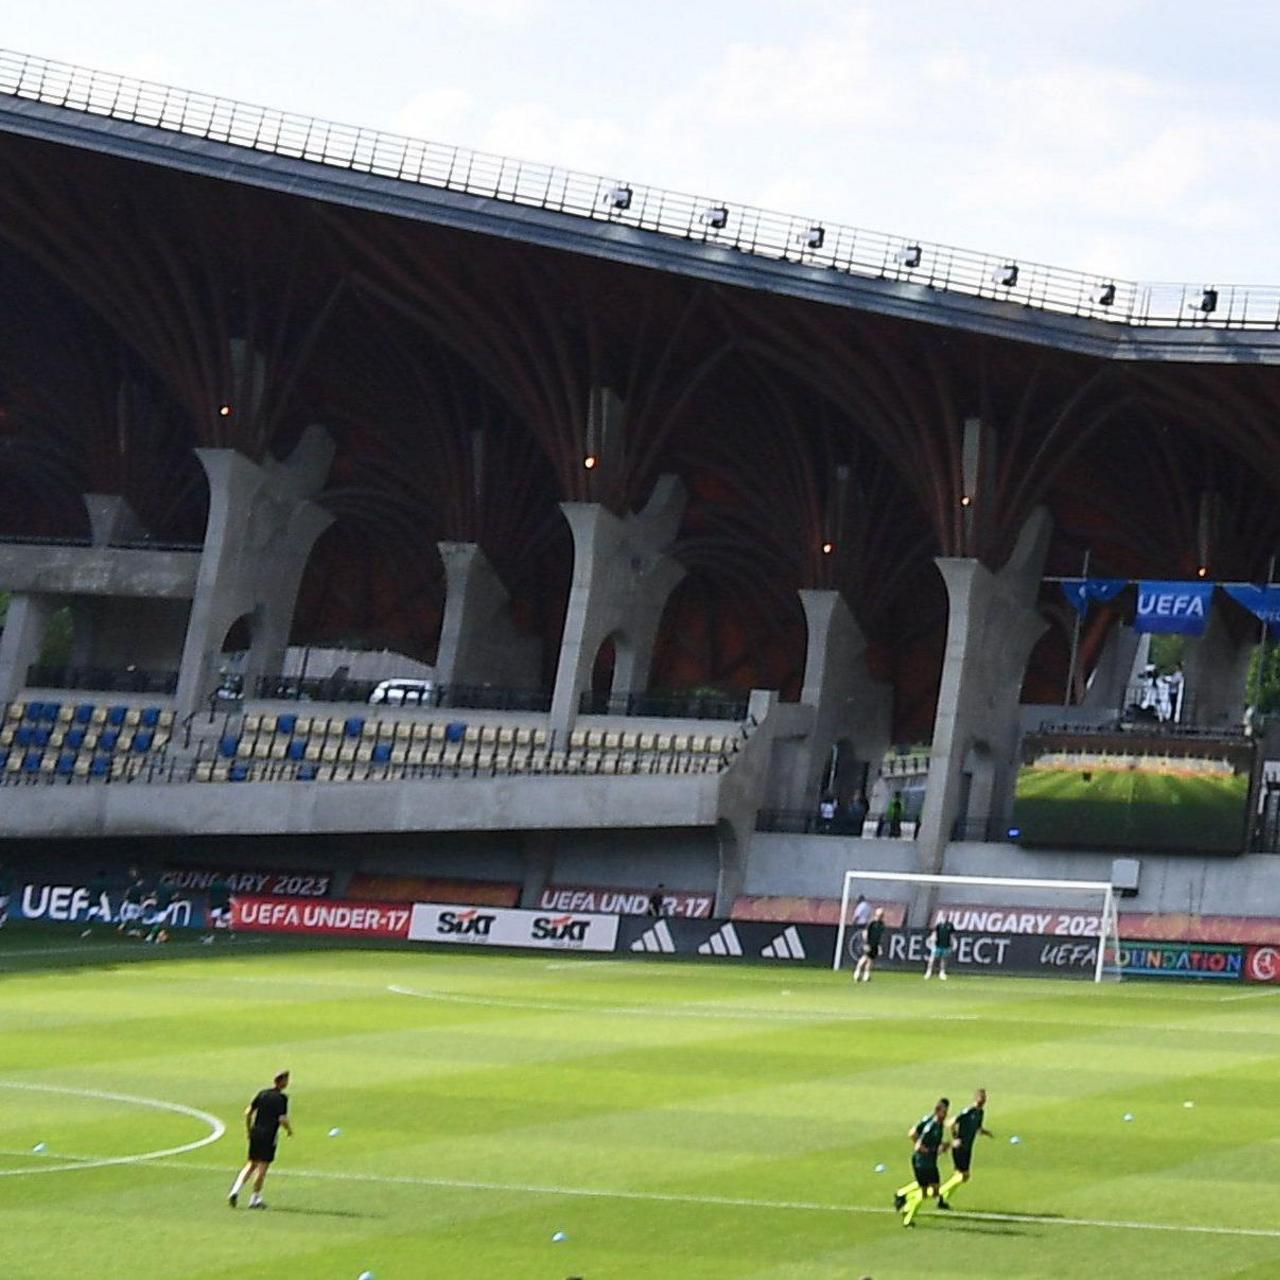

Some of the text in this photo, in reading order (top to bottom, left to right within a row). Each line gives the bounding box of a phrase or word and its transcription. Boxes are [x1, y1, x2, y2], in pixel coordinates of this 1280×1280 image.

[1137, 594, 1205, 617] UEFA
[272, 876, 329, 896] 2023
[240, 902, 409, 931] UEFA UNDER-17
[540, 890, 709, 918] UEFA UNDR-17
[889, 934, 1011, 965] RESECT
[1104, 949, 1242, 971] OUNDATION
